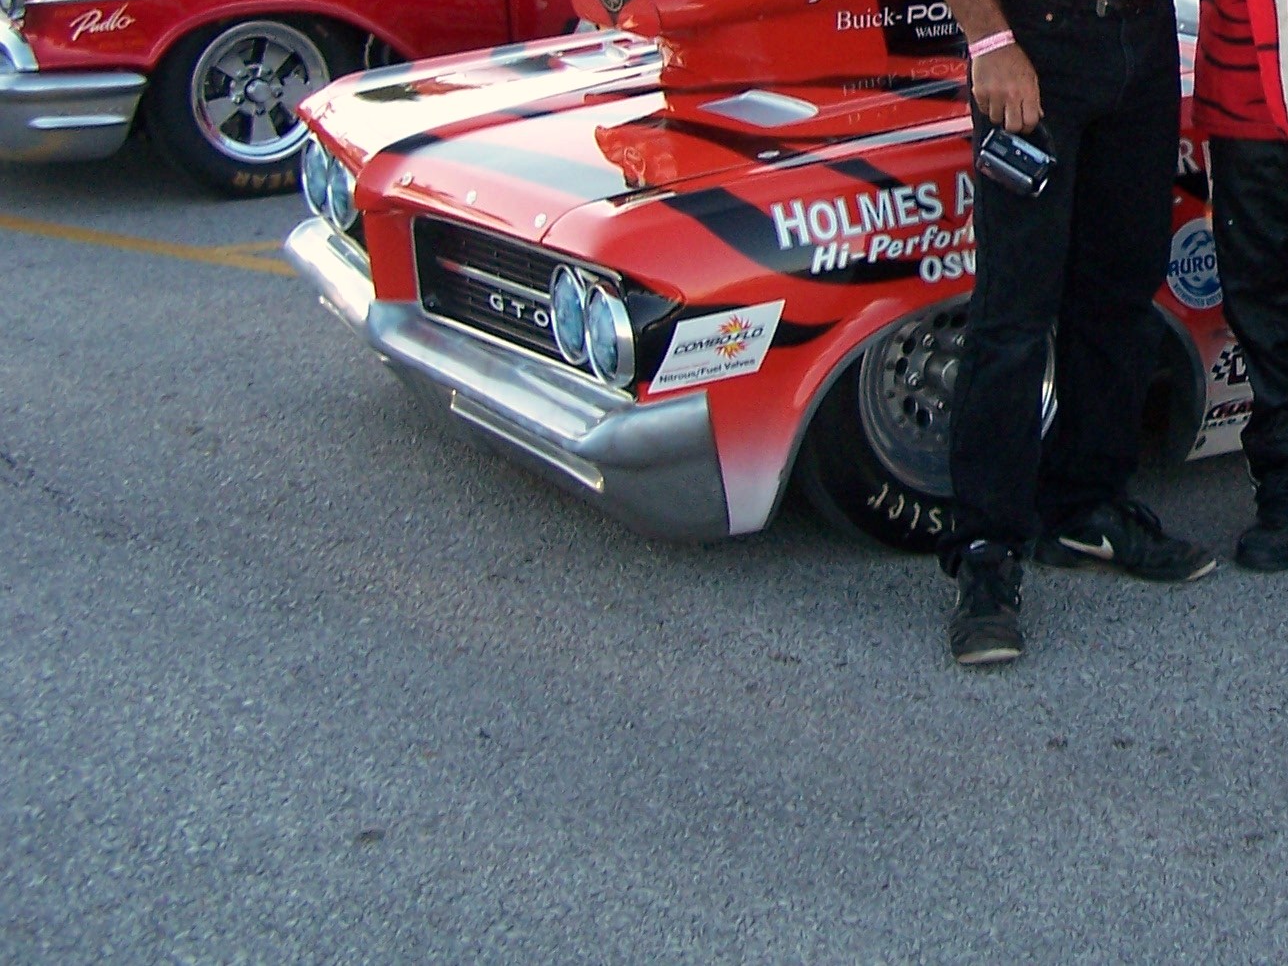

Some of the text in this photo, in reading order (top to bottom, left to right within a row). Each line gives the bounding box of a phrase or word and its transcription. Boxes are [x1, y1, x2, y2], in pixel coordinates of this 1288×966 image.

[770, 182, 944, 250] HOLMES
[489, 294, 549, 328] GTO
[724, 358, 755, 370] Valves
